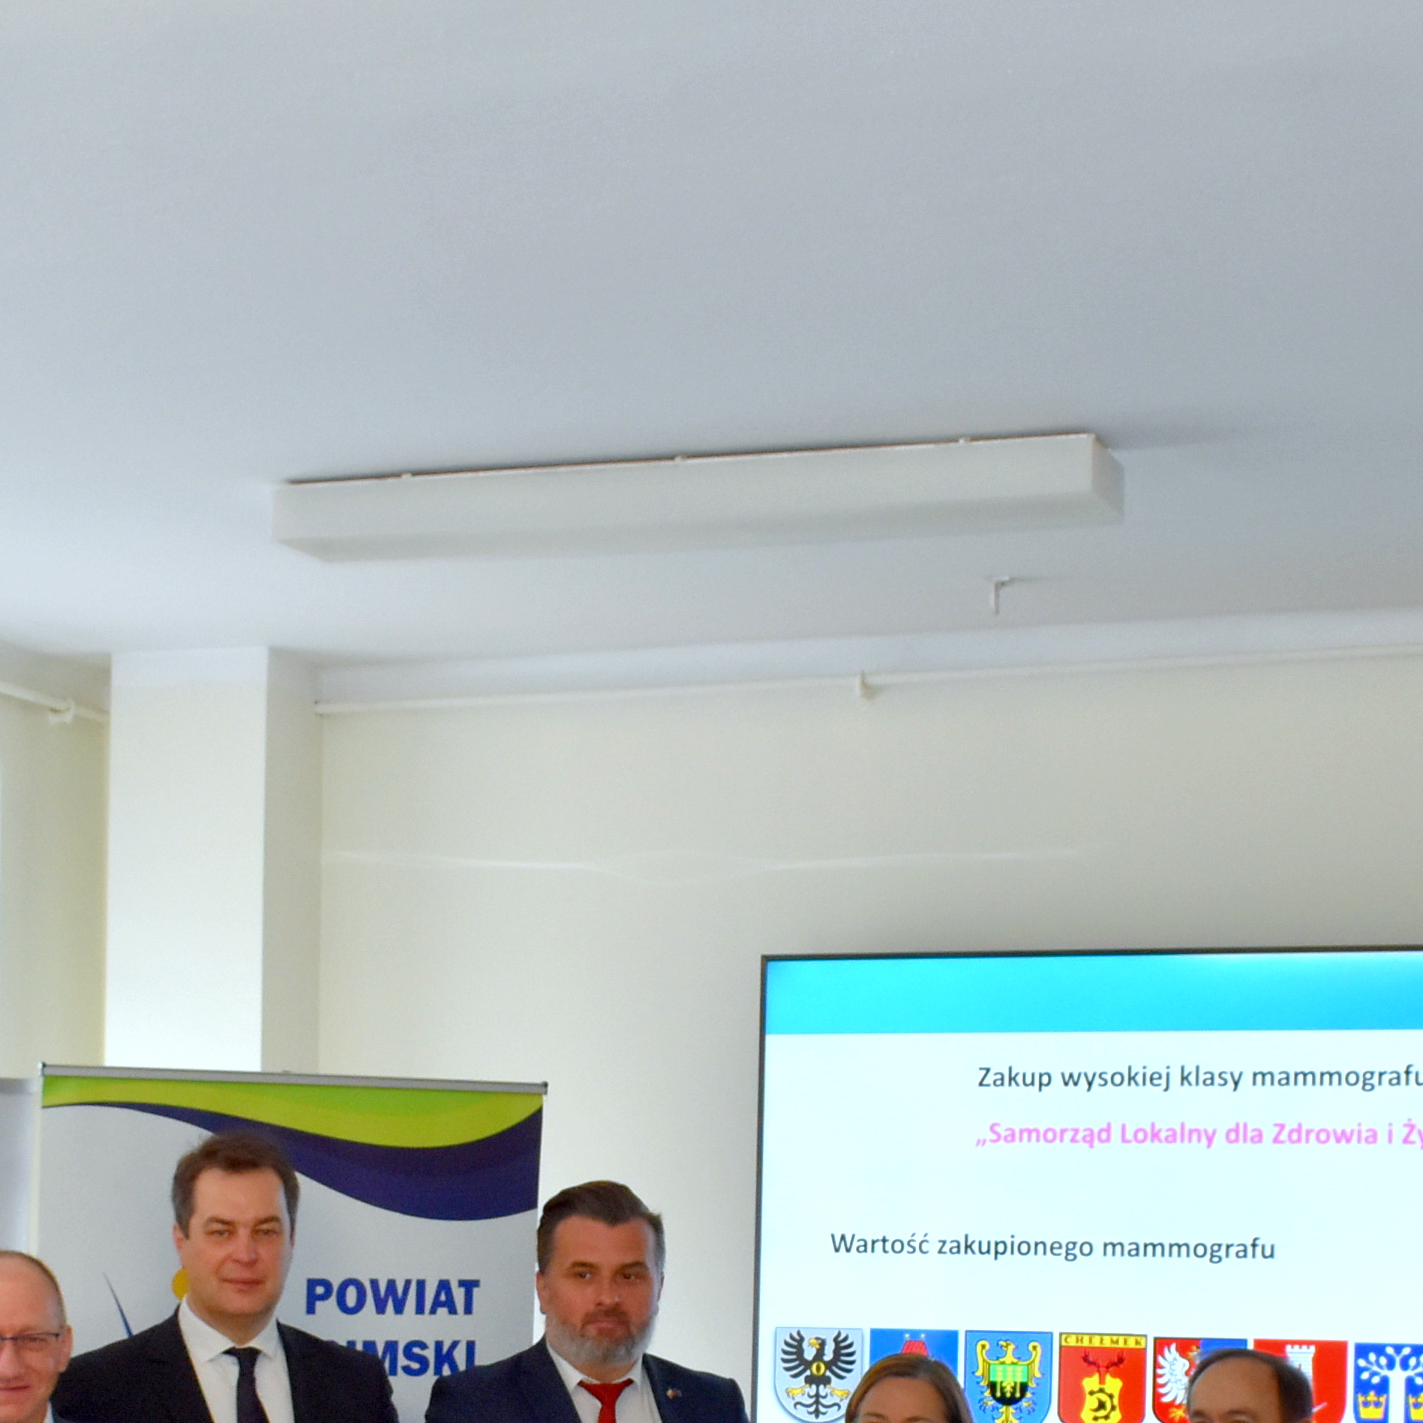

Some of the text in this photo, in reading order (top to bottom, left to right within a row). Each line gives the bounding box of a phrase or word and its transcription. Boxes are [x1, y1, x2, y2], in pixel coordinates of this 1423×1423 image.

[978, 1065, 1053, 1092] Zakup
[1060, 1064, 1171, 1092] wysokiej
[1179, 1064, 1244, 1092] klasy
[1120, 1121, 1218, 1150] Lokalny
[1224, 1121, 1264, 1145] dla
[1271, 1121, 1379, 1146] Zdrowia
[1386, 1121, 1395, 1146] i
[830, 1232, 1277, 1265] Wartość zakupionego mammografu
[305, 1277, 481, 1316] POWIAT
